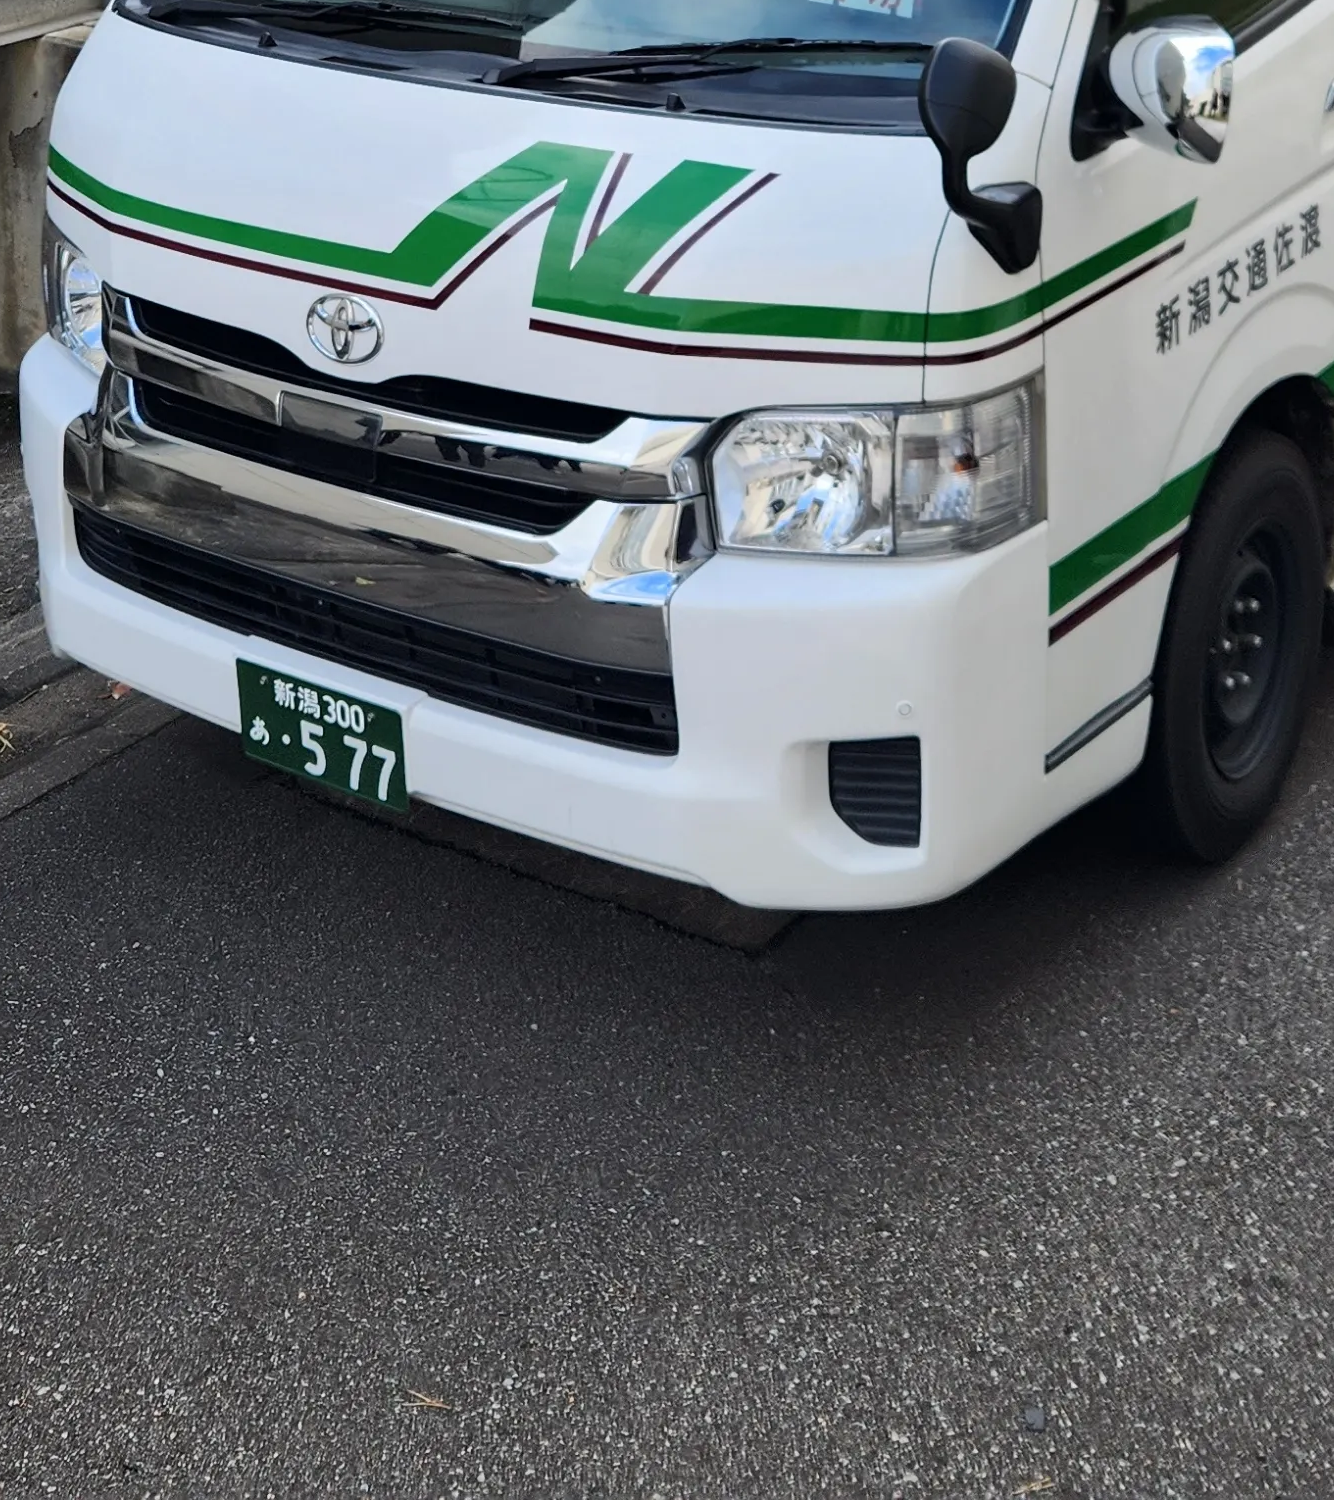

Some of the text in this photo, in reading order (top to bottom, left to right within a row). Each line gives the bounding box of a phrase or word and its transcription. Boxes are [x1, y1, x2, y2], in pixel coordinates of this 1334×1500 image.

[1155, 203, 1322, 355] 新潟交通佐渡
[249, 715, 270, 746] あ
[273, 678, 365, 734] 新潟 300
